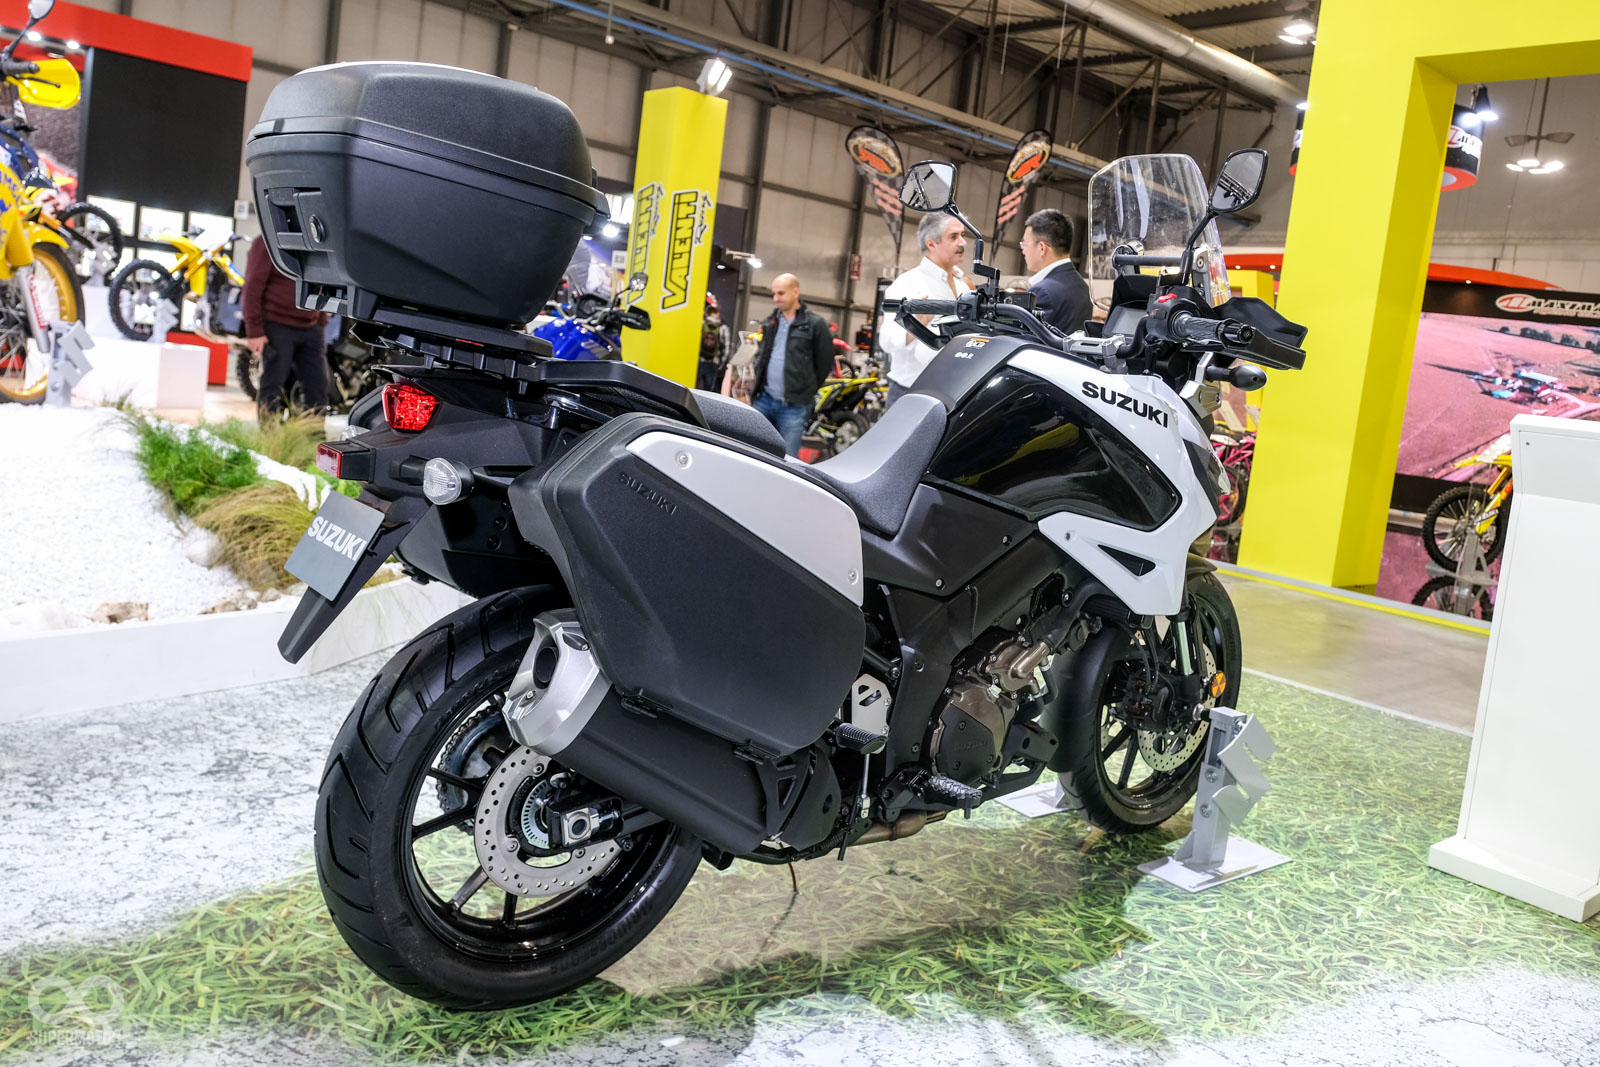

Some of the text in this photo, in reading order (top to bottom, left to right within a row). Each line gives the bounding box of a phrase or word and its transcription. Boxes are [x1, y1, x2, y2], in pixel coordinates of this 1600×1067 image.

[661, 191, 698, 310] VALENTI
[1081, 381, 1168, 428] SUZUKI
[618, 472, 677, 516] SUZUKI
[307, 516, 368, 562] SUZUKI
